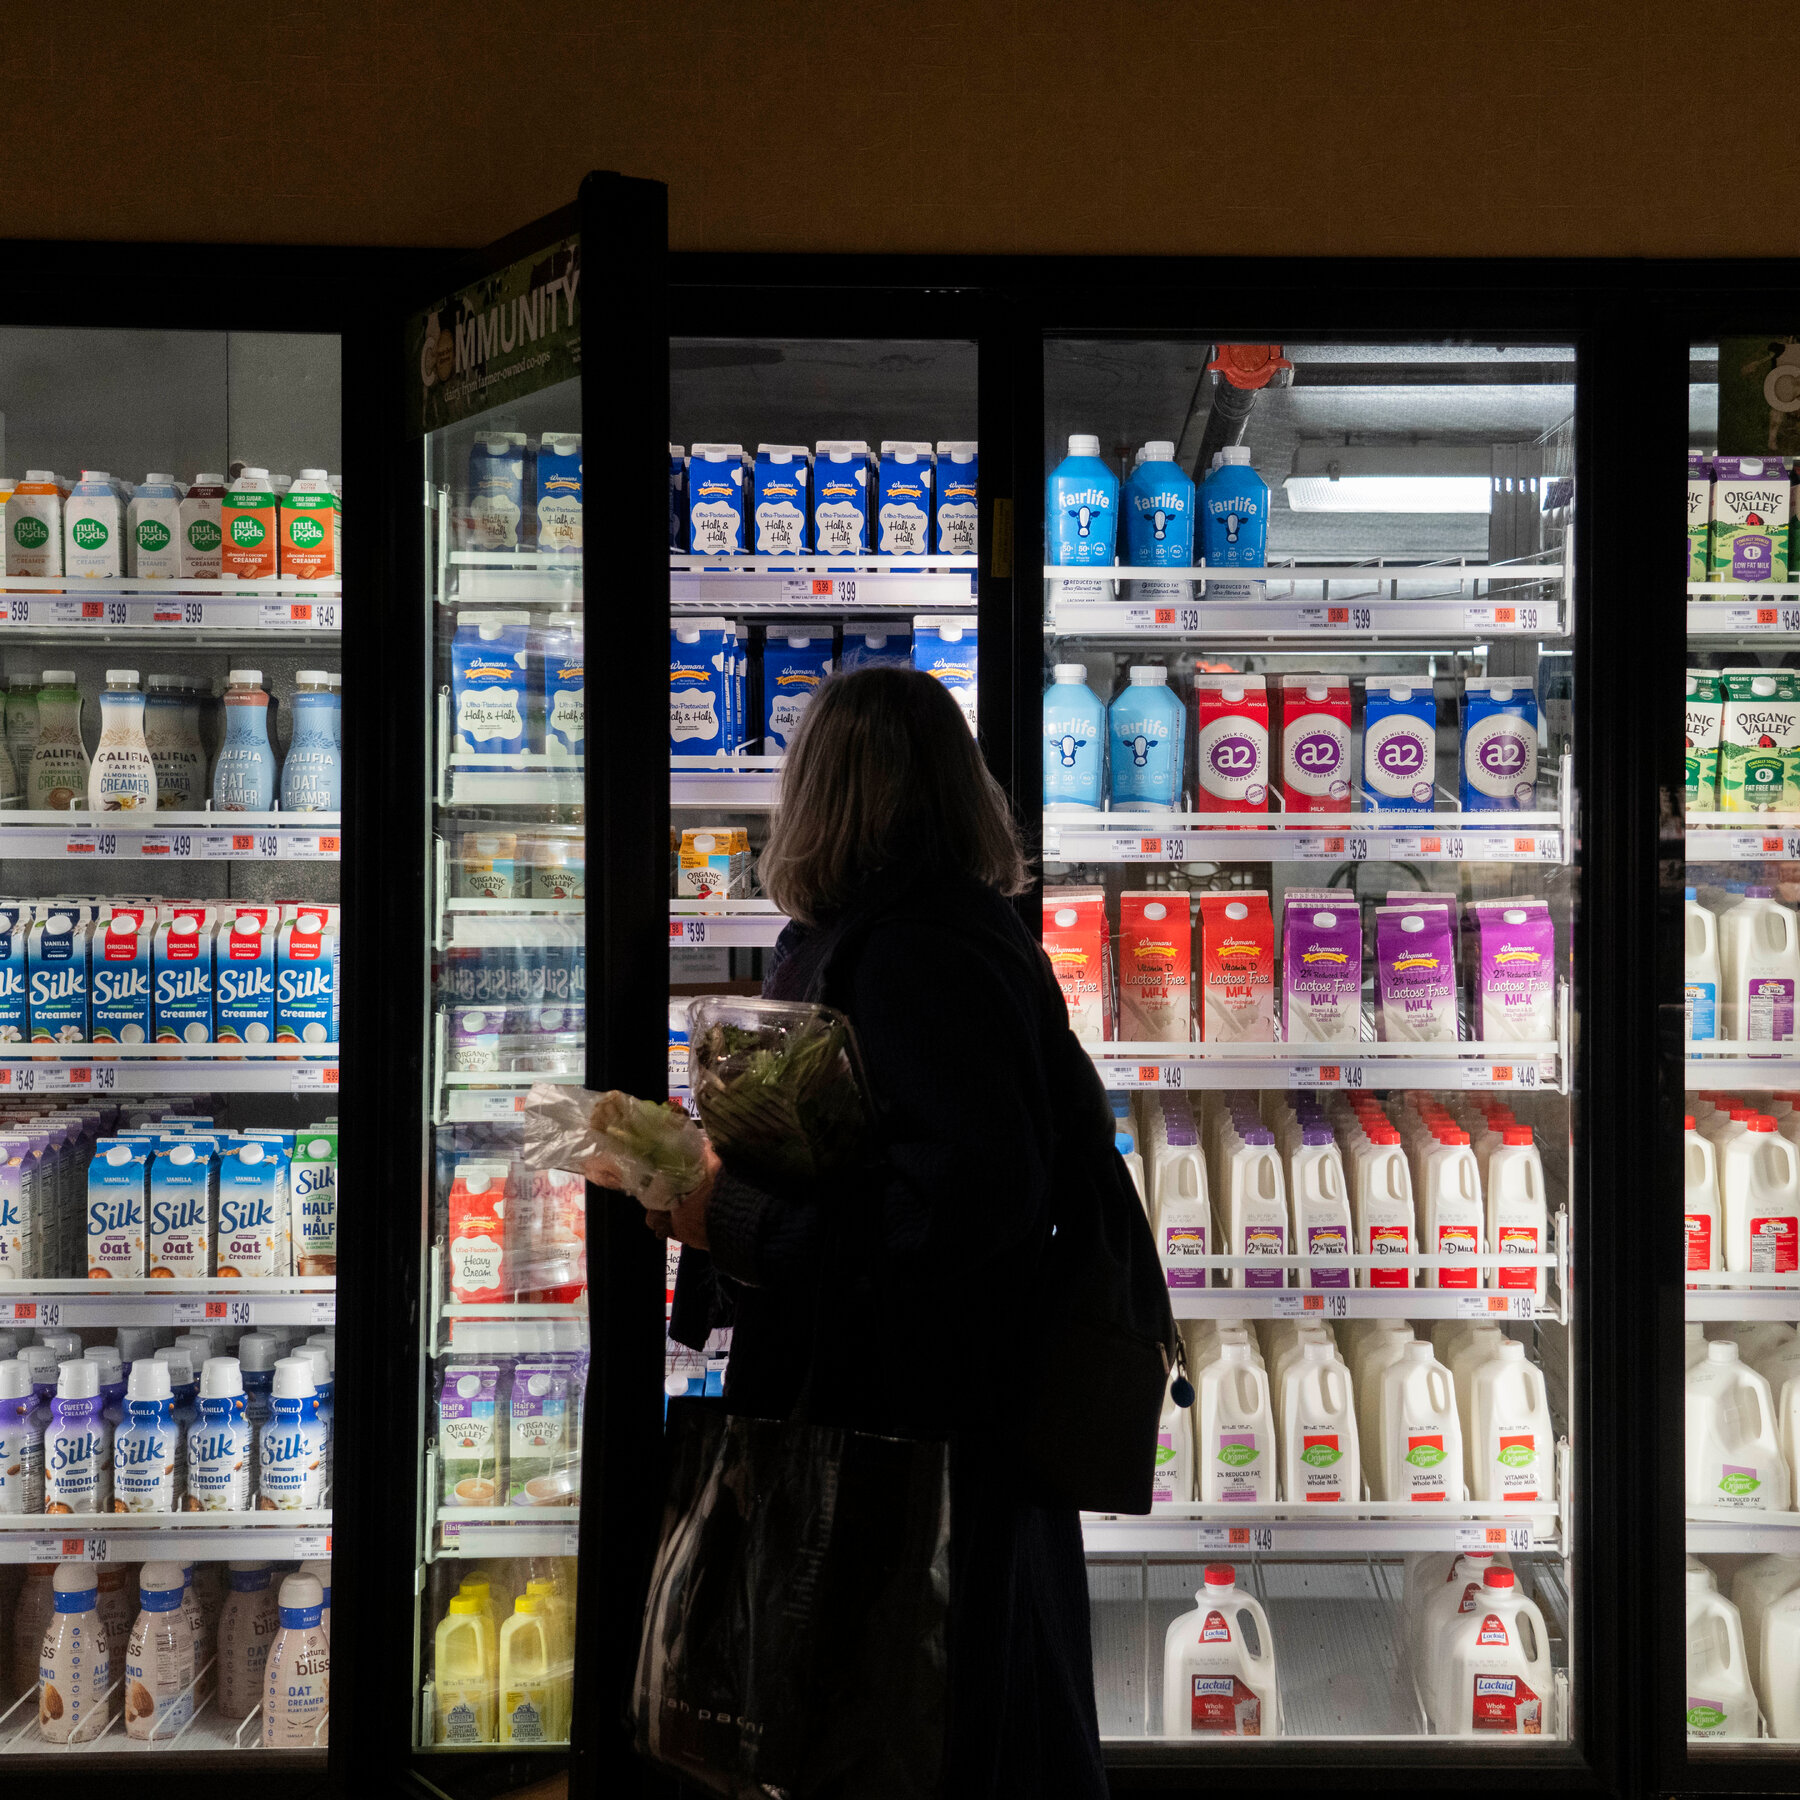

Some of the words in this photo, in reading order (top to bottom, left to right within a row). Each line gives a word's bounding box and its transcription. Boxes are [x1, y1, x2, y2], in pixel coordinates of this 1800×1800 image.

[1724, 491, 1782, 505] ORGANIC
[1730, 502, 1775, 514] VALLEY
[18, 521, 37, 531] nut
[234, 520, 252, 530] nut
[293, 521, 311, 531] nut
[234, 529, 263, 540] pods
[293, 529, 323, 541] pods
[706, 531, 727, 543] Half
[470, 658, 507, 669] Wegmans
[933, 658, 969, 670] Wegmans
[782, 666, 815, 679] Wegmans
[464, 710, 485, 723] Half
[495, 710, 516, 722] Half
[693, 711, 713, 723] Half
[1737, 713, 1796, 726] ORGANIC
[1742, 724, 1791, 735] VALLEY
[36, 749, 85, 761] CALIFIA
[98, 752, 150, 763] CALIFIA
[1218, 746, 1251, 768] a2
[1301, 743, 1335, 765] a2
[1385, 744, 1418, 766] a2
[1487, 744, 1520, 766] a2
[38, 775, 83, 790] CREAMER
[101, 777, 149, 793] CREAMER
[292, 774, 318, 790] OAT
[687, 872, 721, 881] ORGANIC
[1140, 937, 1172, 948] Wegmans
[1500, 942, 1534, 954] Wegmans
[1221, 963, 1247, 972] Vitamin
[1125, 974, 1162, 986] Lactose
[1164, 972, 1186, 985] Free
[1210, 972, 1246, 985] Lactose
[1248, 971, 1270, 984] Free
[30, 968, 87, 1006] Silk
[93, 968, 150, 1006] Silk
[155, 967, 212, 1004] Silk
[217, 967, 274, 1004] Silk
[277, 967, 333, 1004] Silk
[1294, 979, 1332, 992] Lactose
[1333, 979, 1356, 992] Free
[1387, 985, 1425, 998] Lactose
[1426, 985, 1449, 998] Free
[1487, 979, 1525, 992] Lactose
[1526, 979, 1549, 992] Free
[1142, 987, 1168, 999] MILK
[1226, 987, 1252, 998] MILK
[1311, 994, 1338, 1006] MILK
[1405, 1000, 1432, 1012] MILK
[1505, 994, 1532, 1006] MILK
[34, 1011, 82, 1019] Creamer
[97, 1011, 144, 1019] Creamer
[161, 1010, 207, 1018] Creamer
[222, 1010, 269, 1018] Creamer
[281, 1010, 327, 1018] Creamer
[302, 1202, 335, 1215] HALF
[88, 1201, 144, 1235] Silk
[151, 1200, 207, 1235] Silk
[219, 1199, 275, 1234] Silk
[303, 1223, 335, 1236] HALF
[100, 1241, 131, 1254] Oat
[162, 1241, 193, 1254] Oat
[230, 1241, 261, 1254] Oat
[464, 1256, 490, 1268] Heavy
[463, 1267, 492, 1277] Cream
[446, 1423, 488, 1433] ORGANIC
[451, 1431, 483, 1439] VALLEY
[51, 1433, 104, 1470] Silk
[115, 1436, 165, 1469] Silk
[188, 1434, 237, 1466] Silk
[261, 1434, 312, 1466] Silk
[55, 1473, 100, 1485] Almond
[117, 1476, 159, 1487] Almond
[190, 1473, 231, 1483] Almond
[264, 1472, 307, 1483] Almond
[299, 1648, 326, 1660] natural
[296, 1657, 330, 1676] bliss
[1197, 1680, 1231, 1690] Lactaid
[1479, 1679, 1513, 1690] Lactaid
[288, 1686, 311, 1697] OAT
[288, 1697, 324, 1707] CREAMER
